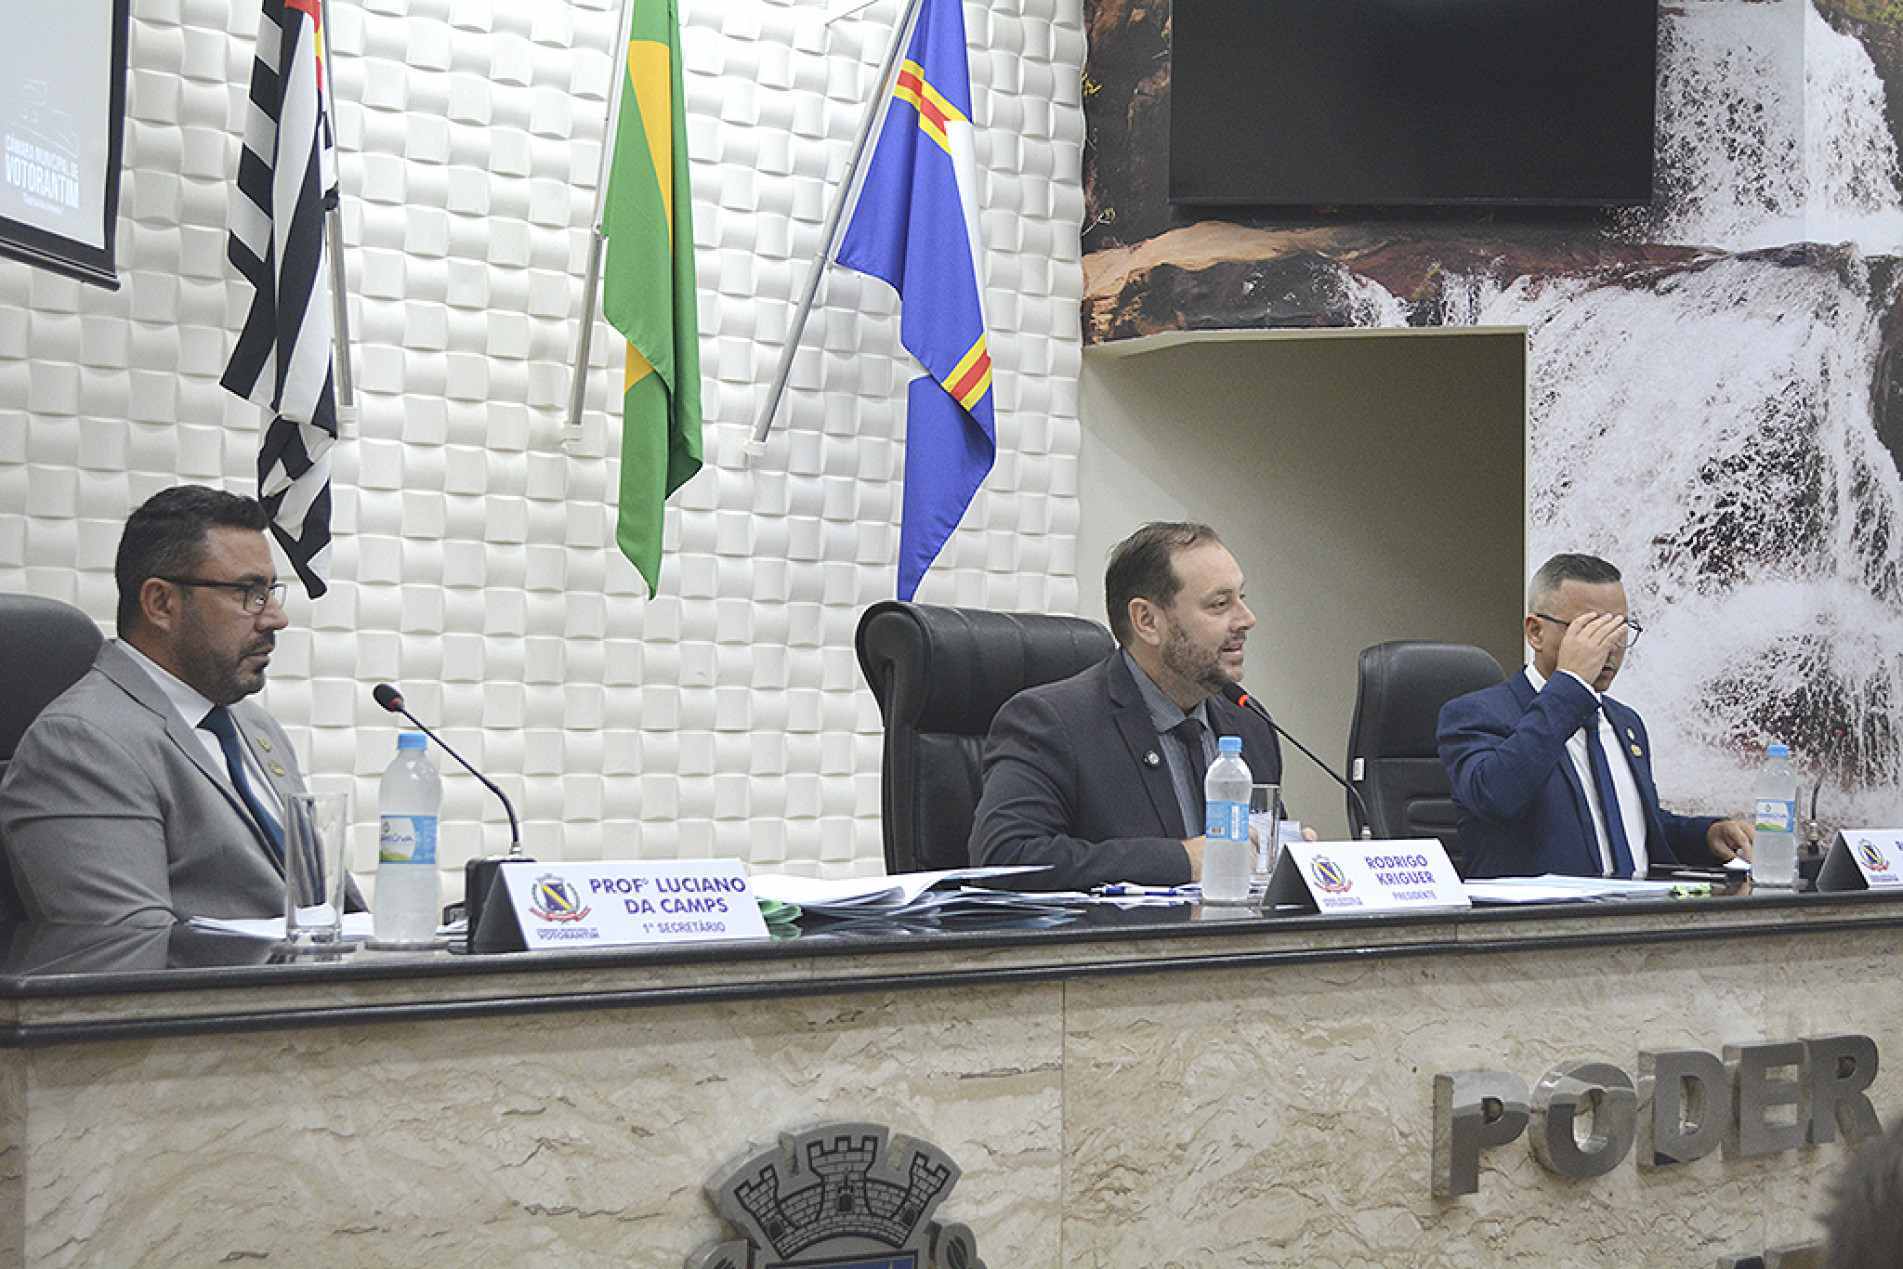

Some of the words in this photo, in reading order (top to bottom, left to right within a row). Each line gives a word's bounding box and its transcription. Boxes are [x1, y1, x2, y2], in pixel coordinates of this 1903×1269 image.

[1365, 854, 1428, 869] RODRIGO
[656, 876, 746, 893] LUCIANO
[1376, 871, 1436, 886] KRIGUER
[625, 898, 656, 914] DA
[661, 897, 729, 914] CAMPS
[659, 920, 726, 934] SECRETÁRIO
[1431, 1034, 1883, 1200] PODER
